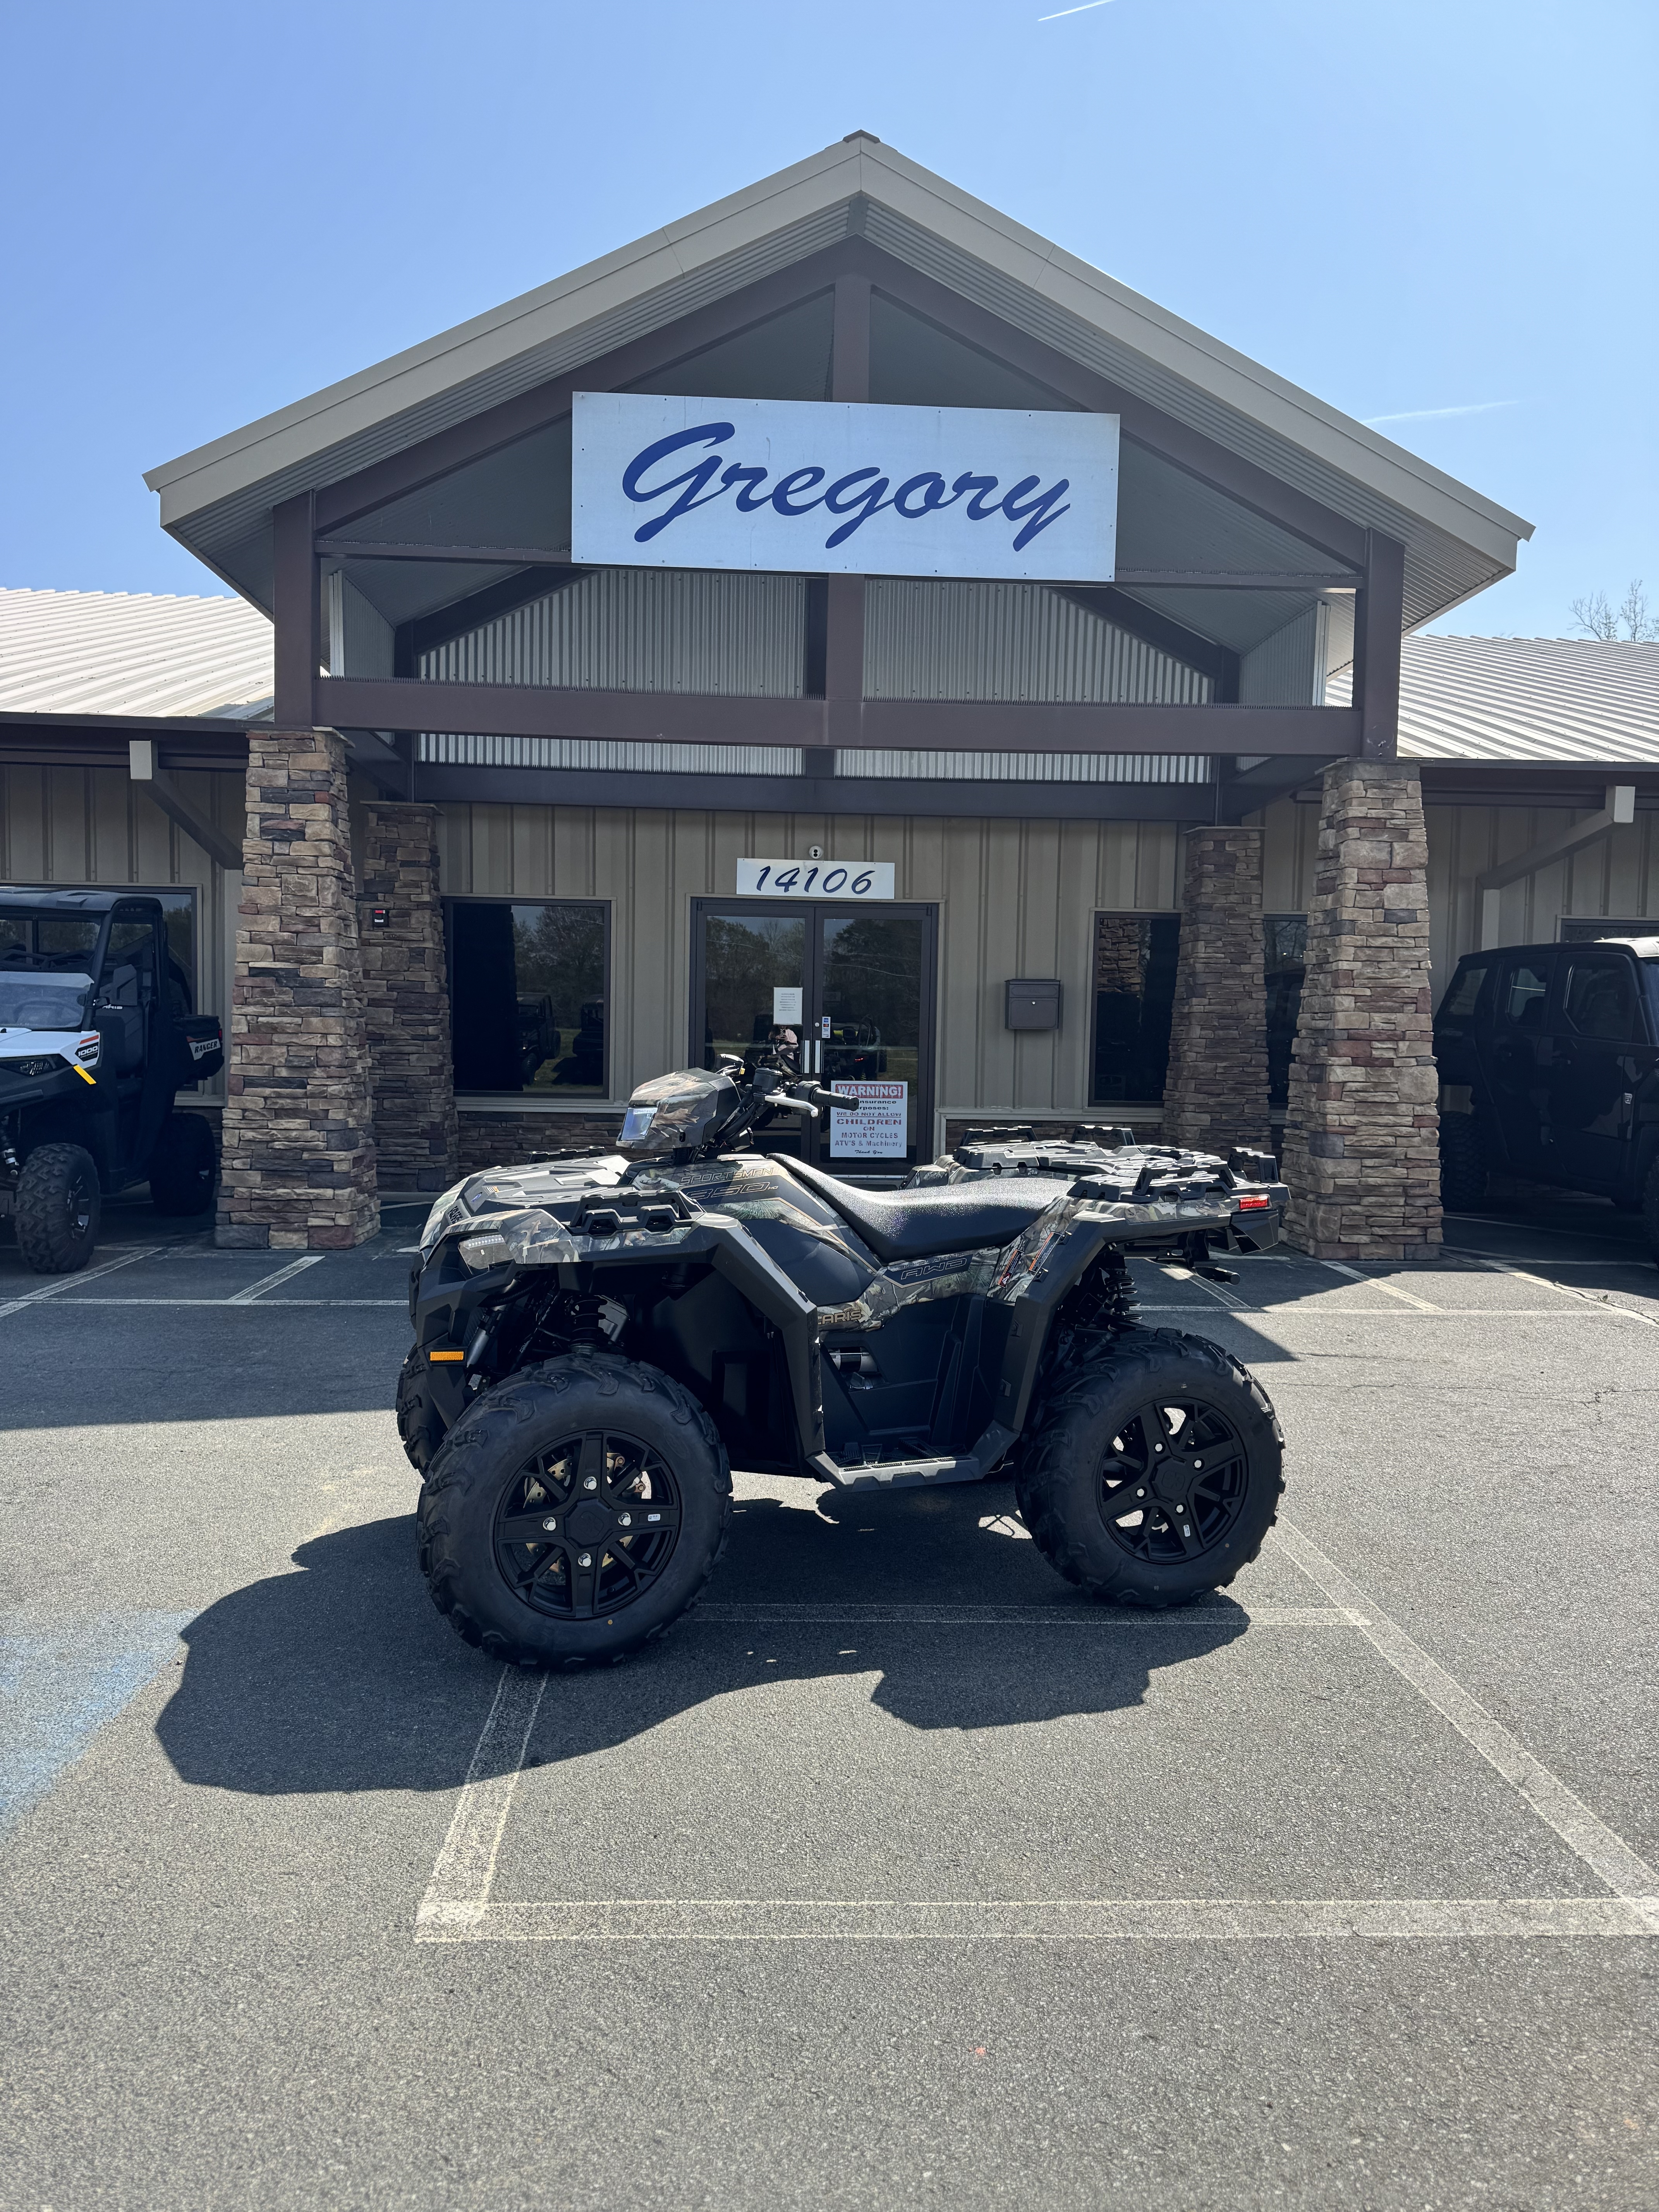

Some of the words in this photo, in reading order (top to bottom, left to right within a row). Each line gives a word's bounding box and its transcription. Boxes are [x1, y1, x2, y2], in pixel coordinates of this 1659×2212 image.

[622, 422, 1070, 552] Gregory
[756, 866, 876, 895] 14106
[78, 1045, 98, 1057] 1000
[194, 1041, 218, 1054] RANGER
[837, 1085, 901, 1097] WARNING!
[679, 1167, 774, 1185] SPORTSMAN
[686, 1182, 770, 1200] 850
[900, 1258, 967, 1280] AWD
[818, 1309, 862, 1325] ARIS
